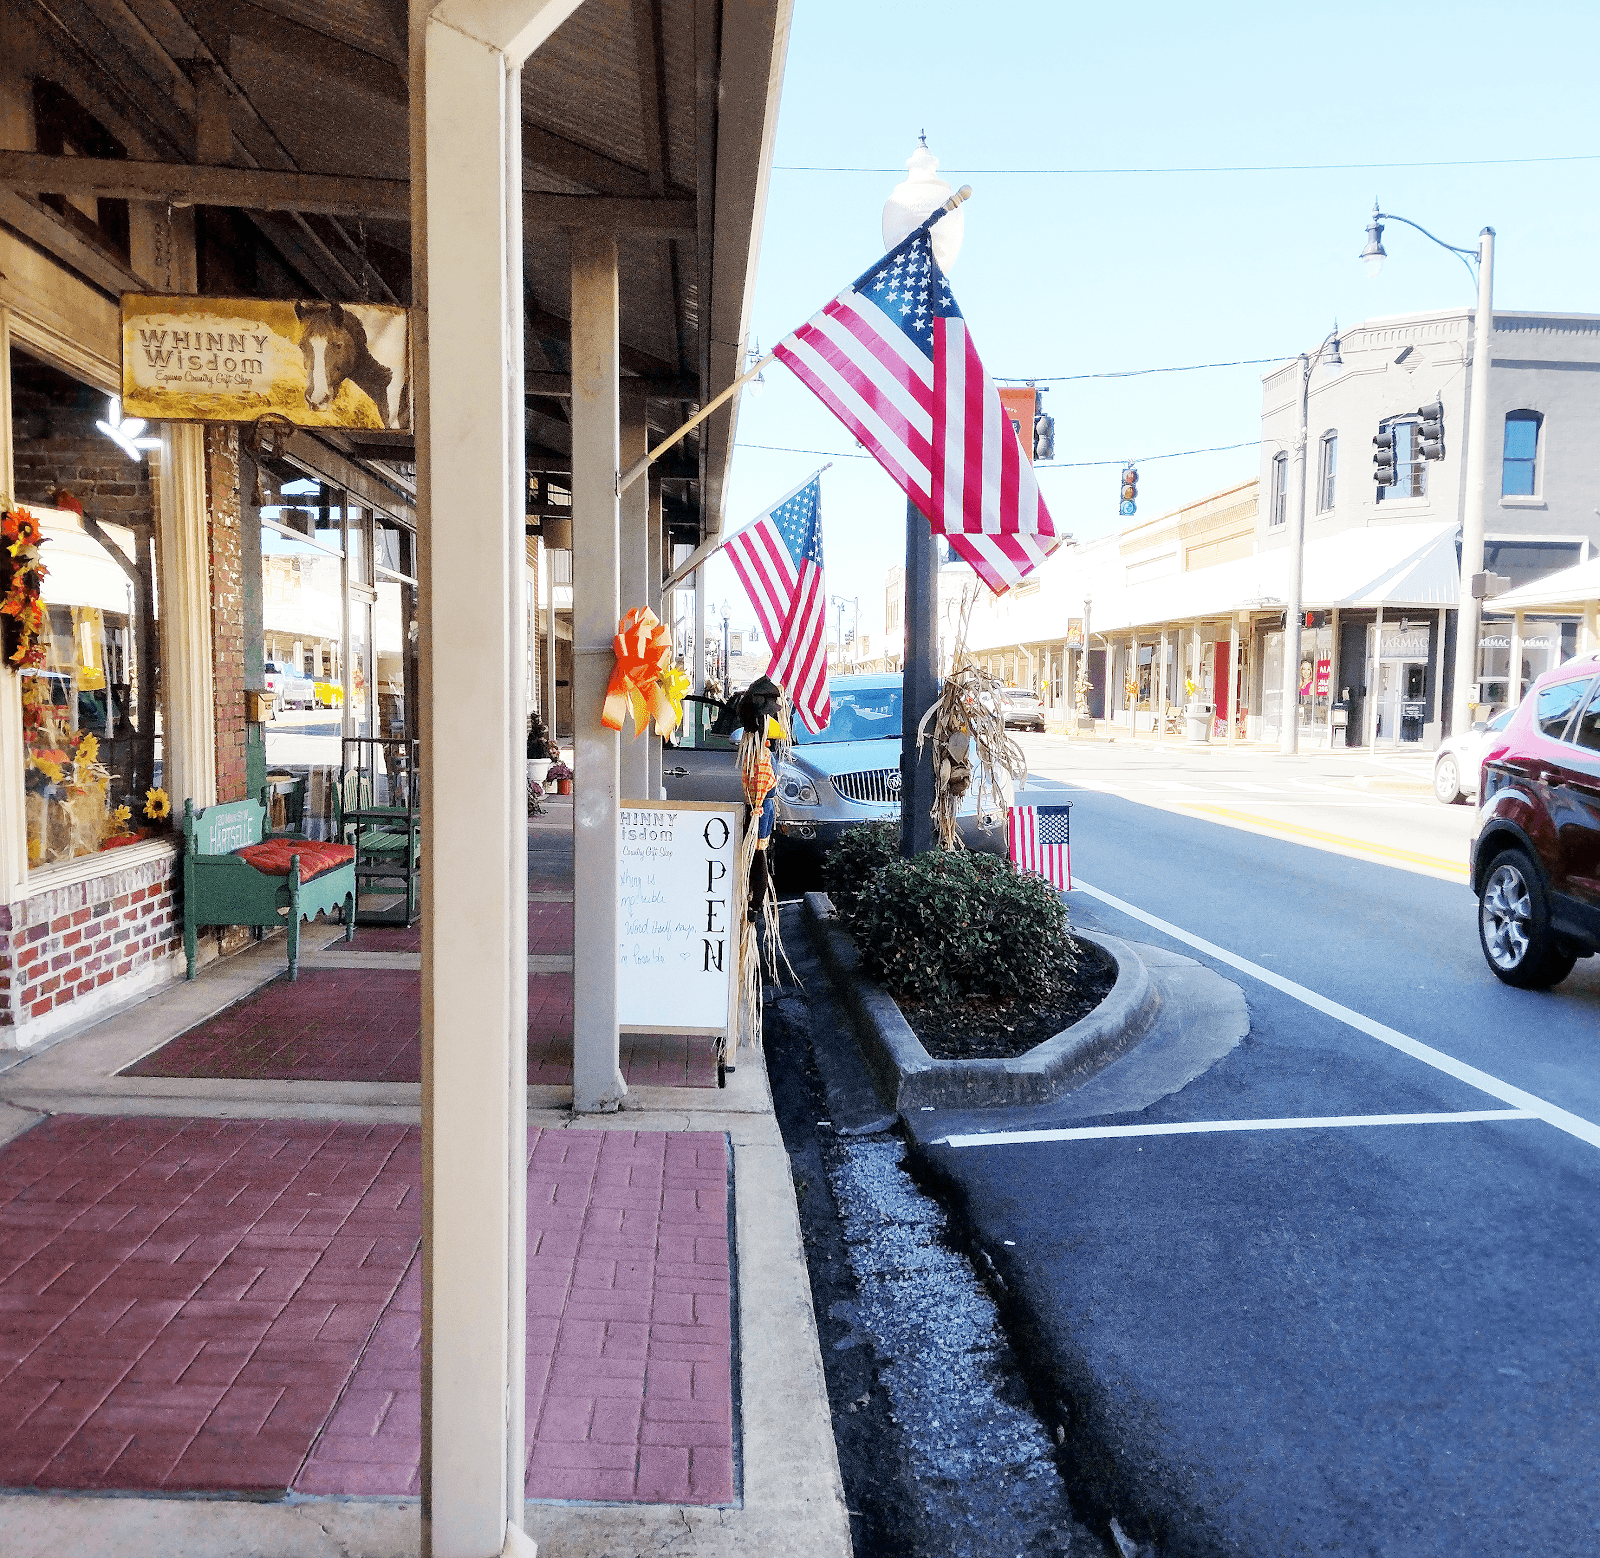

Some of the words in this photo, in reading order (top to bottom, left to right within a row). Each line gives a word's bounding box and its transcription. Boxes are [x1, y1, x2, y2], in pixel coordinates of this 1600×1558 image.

[138, 329, 268, 354] WHINNY
[144, 349, 264, 374] Wisdom
[619, 811, 678, 827] HINNY
[209, 817, 254, 855] HARTSELLE
[621, 826, 673, 842] isdom
[699, 817, 731, 973] OPEN
